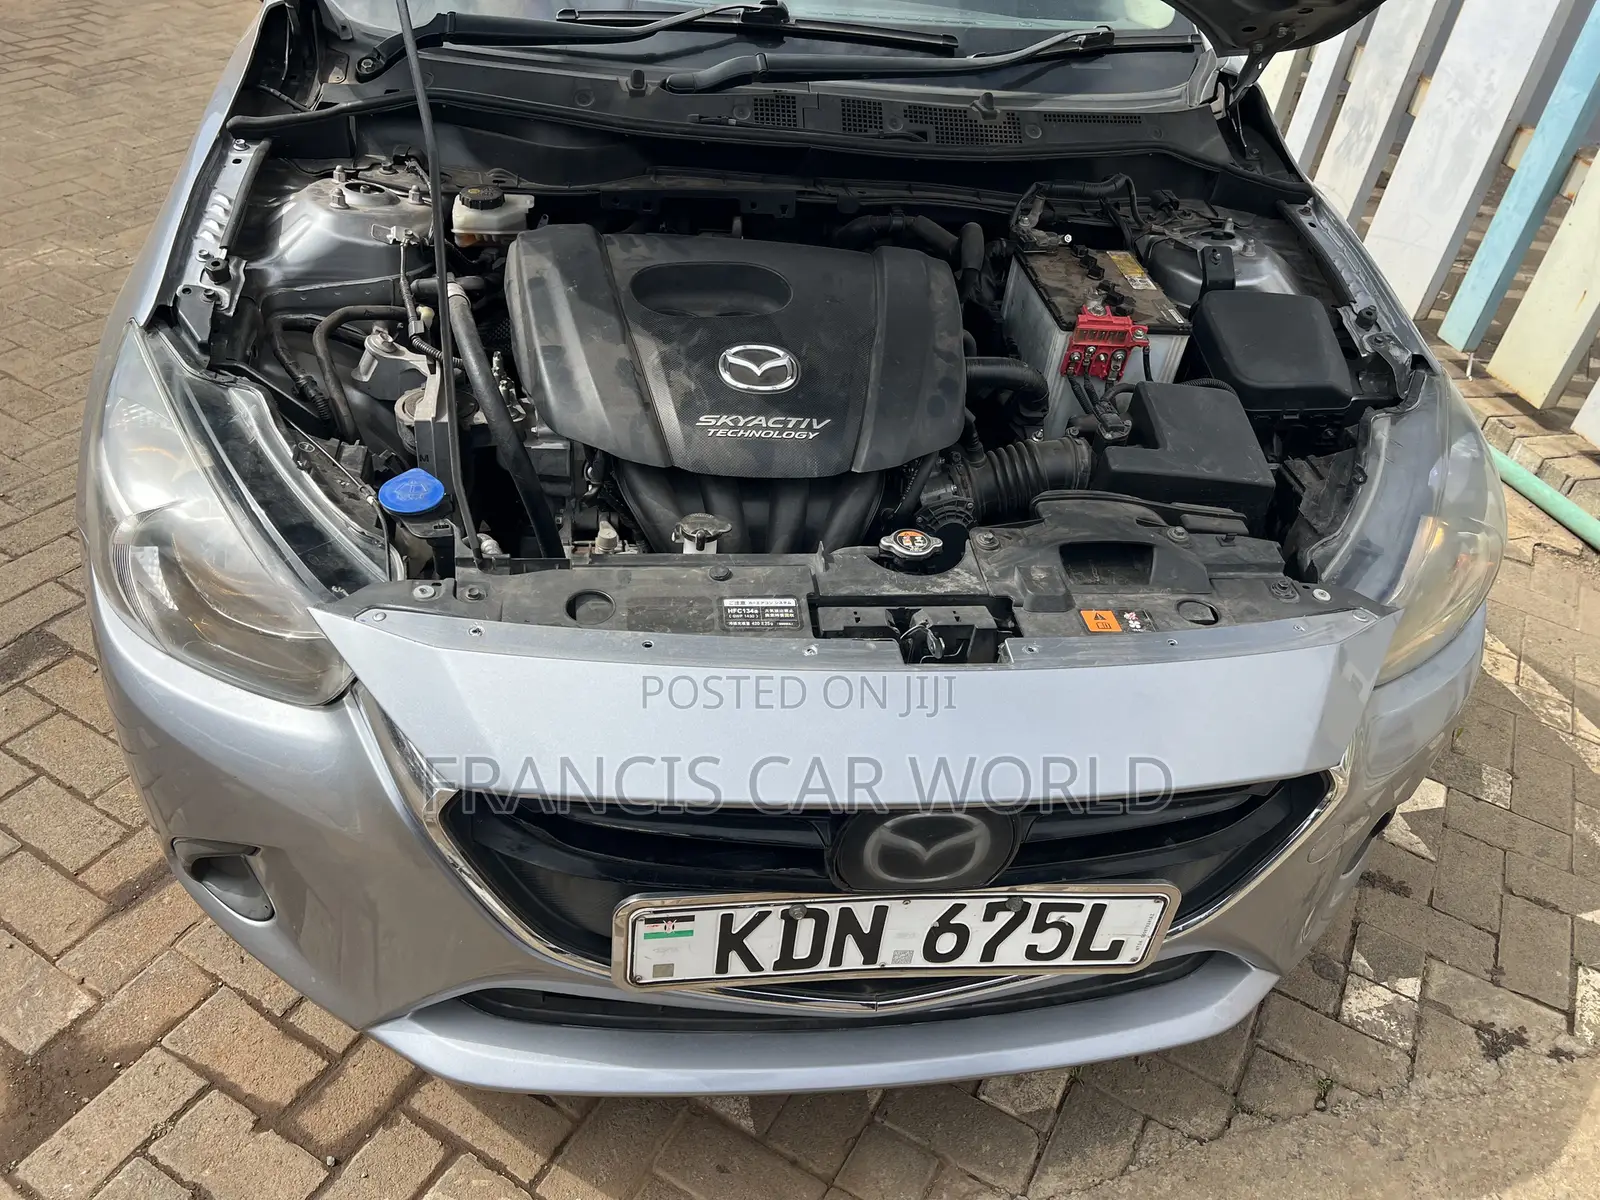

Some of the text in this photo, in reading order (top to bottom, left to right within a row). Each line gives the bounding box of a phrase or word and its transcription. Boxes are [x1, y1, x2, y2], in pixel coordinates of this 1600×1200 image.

[696, 415, 831, 429] SKYACTIV
[707, 428, 819, 440] TECHNOLOGY
[714, 901, 1126, 975] KDN 675L
